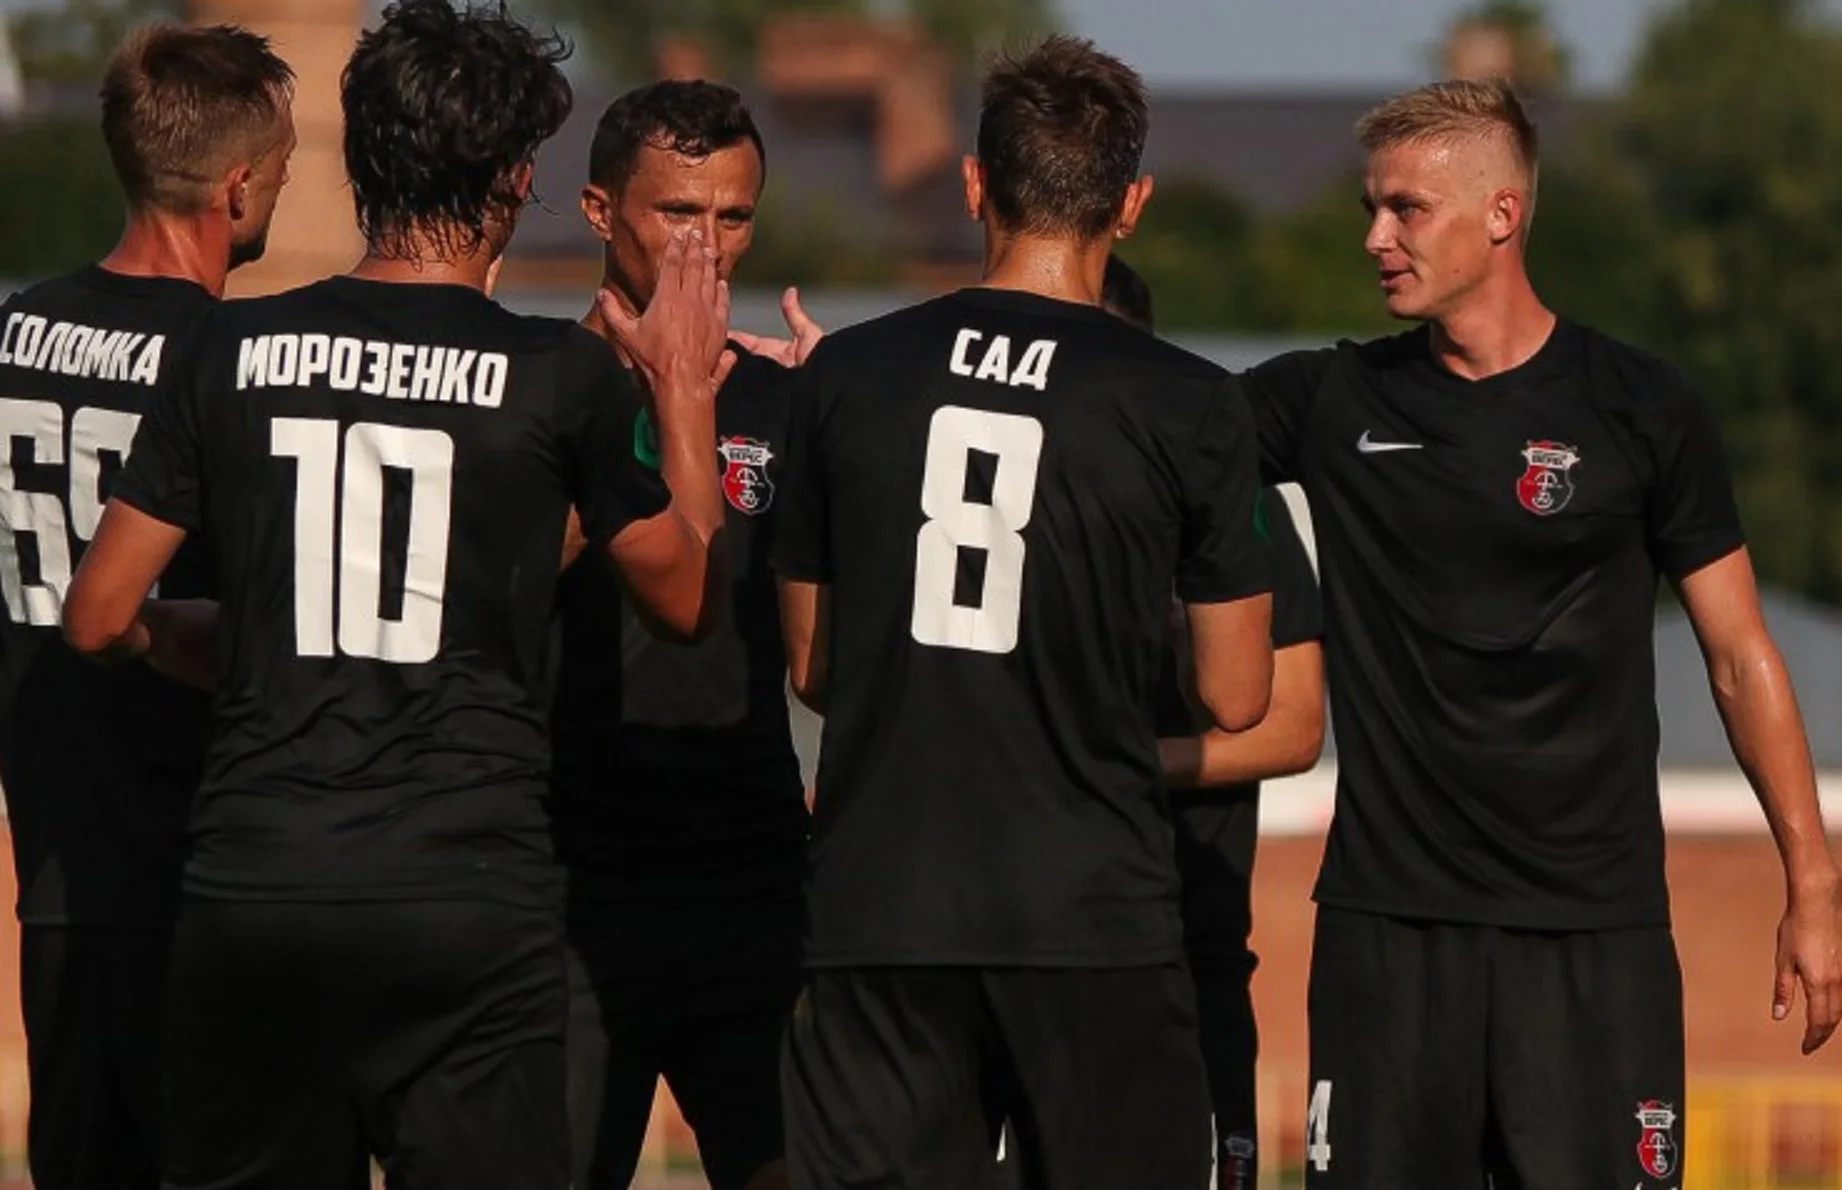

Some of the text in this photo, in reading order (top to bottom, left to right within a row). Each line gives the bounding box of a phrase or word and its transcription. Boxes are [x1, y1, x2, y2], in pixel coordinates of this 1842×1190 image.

[0, 312, 165, 385] СОЛОМКА
[236, 334, 508, 408] МОРОЗЕНКО
[950, 328, 1057, 390] САД
[270, 417, 454, 663] 10
[911, 405, 1043, 653] 8
[1307, 1080, 1332, 1171] 4
